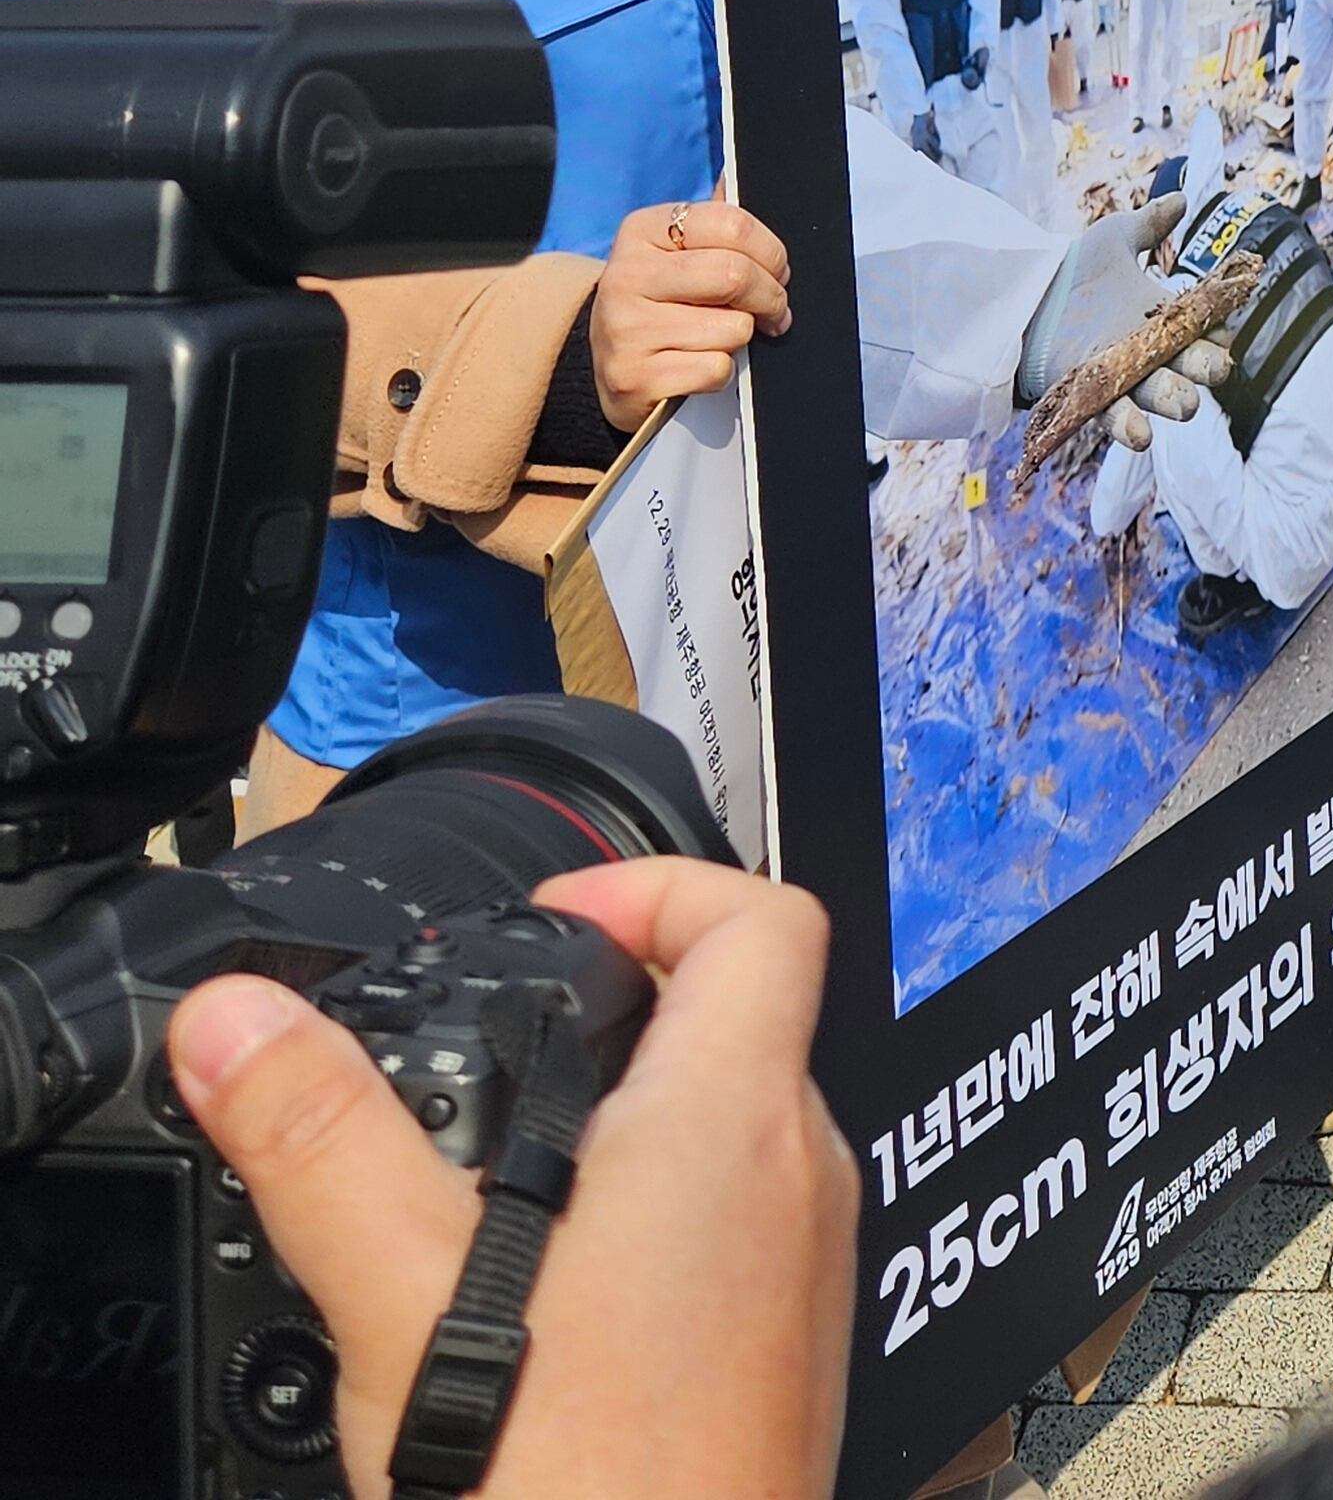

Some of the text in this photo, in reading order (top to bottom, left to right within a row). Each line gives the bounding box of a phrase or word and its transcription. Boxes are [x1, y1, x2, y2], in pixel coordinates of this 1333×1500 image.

[648, 488, 672, 547] 12.29
[675, 623, 707, 700] 제주항공
[871, 1010, 1055, 1206] 1년만에
[1071, 930, 1161, 1060] 잔해
[1175, 828, 1295, 970] 속에서
[878, 1136, 1087, 1357] 25cm
[1104, 923, 1315, 1168] 희생자의
[1145, 1126, 1238, 1221] 무안공항 제주항공
[1146, 1116, 1277, 1248] 여객기 참사 유가족 협의회
[219, 1242, 251, 1258] INFO
[1094, 1237, 1140, 1296] 1229
[270, 1385, 301, 1404] SET
